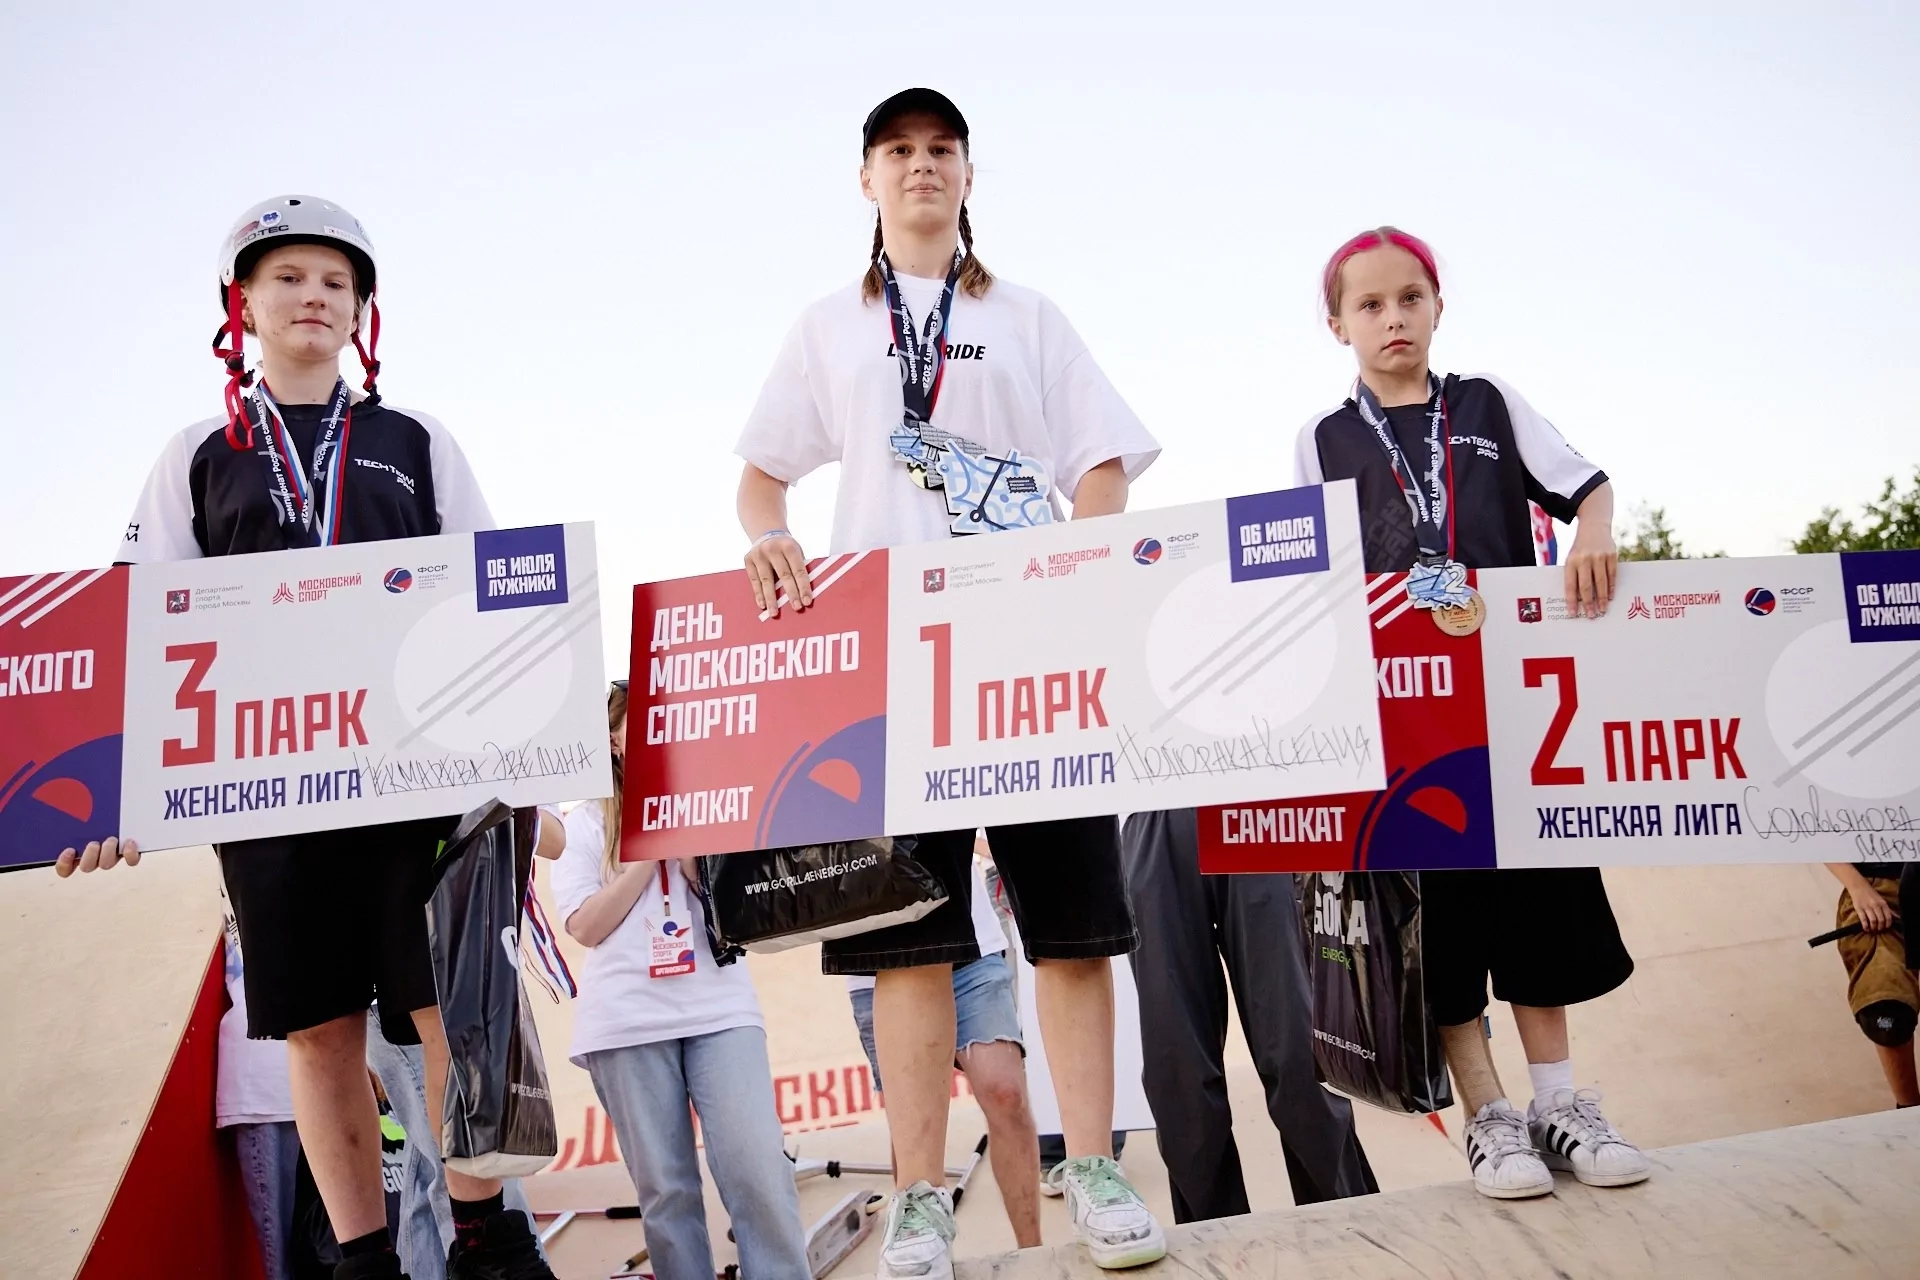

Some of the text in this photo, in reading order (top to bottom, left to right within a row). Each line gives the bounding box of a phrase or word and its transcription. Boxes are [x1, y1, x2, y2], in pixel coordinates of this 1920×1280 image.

[1477, 448, 1499, 460] PRO
[1167, 533, 1199, 542] ФССР
[1239, 516, 1315, 547] 06 ИЮЛЯ
[1048, 544, 1111, 567] МОСКОВСКИЙ
[1241, 538, 1317, 567] ЛУЖНИКИ
[417, 564, 448, 573] ФССР
[487, 553, 556, 579] 06 ИЮЛЯ
[1048, 563, 1078, 578] СПОРТ
[194, 584, 244, 595] Департамент
[299, 572, 362, 591] МОСКОВСКИЙ
[488, 573, 557, 597] ЛУЖНИКИ
[1780, 587, 1814, 595] ФССР
[1856, 581, 1920, 606] 06 ИЮЛ
[195, 598, 251, 611] города Москвы
[299, 589, 328, 603] СПОРТ
[1653, 590, 1721, 607] МОСКОВСКИЙ
[1654, 606, 1686, 619] СПОРТ
[1861, 605, 1920, 627] ЛУЖНИ
[650, 601, 723, 653] ДЕНЬ
[649, 630, 860, 697] МОСКОВСКОГО
[1373, 655, 1453, 698] КОГО
[920, 622, 1109, 748] 1 ПАРК
[162, 641, 370, 768] 3 ПАРК
[646, 693, 757, 746] СПОРТА
[1522, 656, 1748, 786] 2 ПАРК
[925, 751, 1115, 802] ЖЕНСКАЯ ЛИГА
[164, 768, 362, 821] ЖЕНСКАЯ ЛИГА
[642, 785, 754, 832] САМОКАТ
[1536, 803, 1743, 839] ЖЕНСКАЯ ЛИГА
[1222, 806, 1346, 844] САМОКАТ
[744, 854, 878, 896] WWW.GORILLAENERGY.COM
